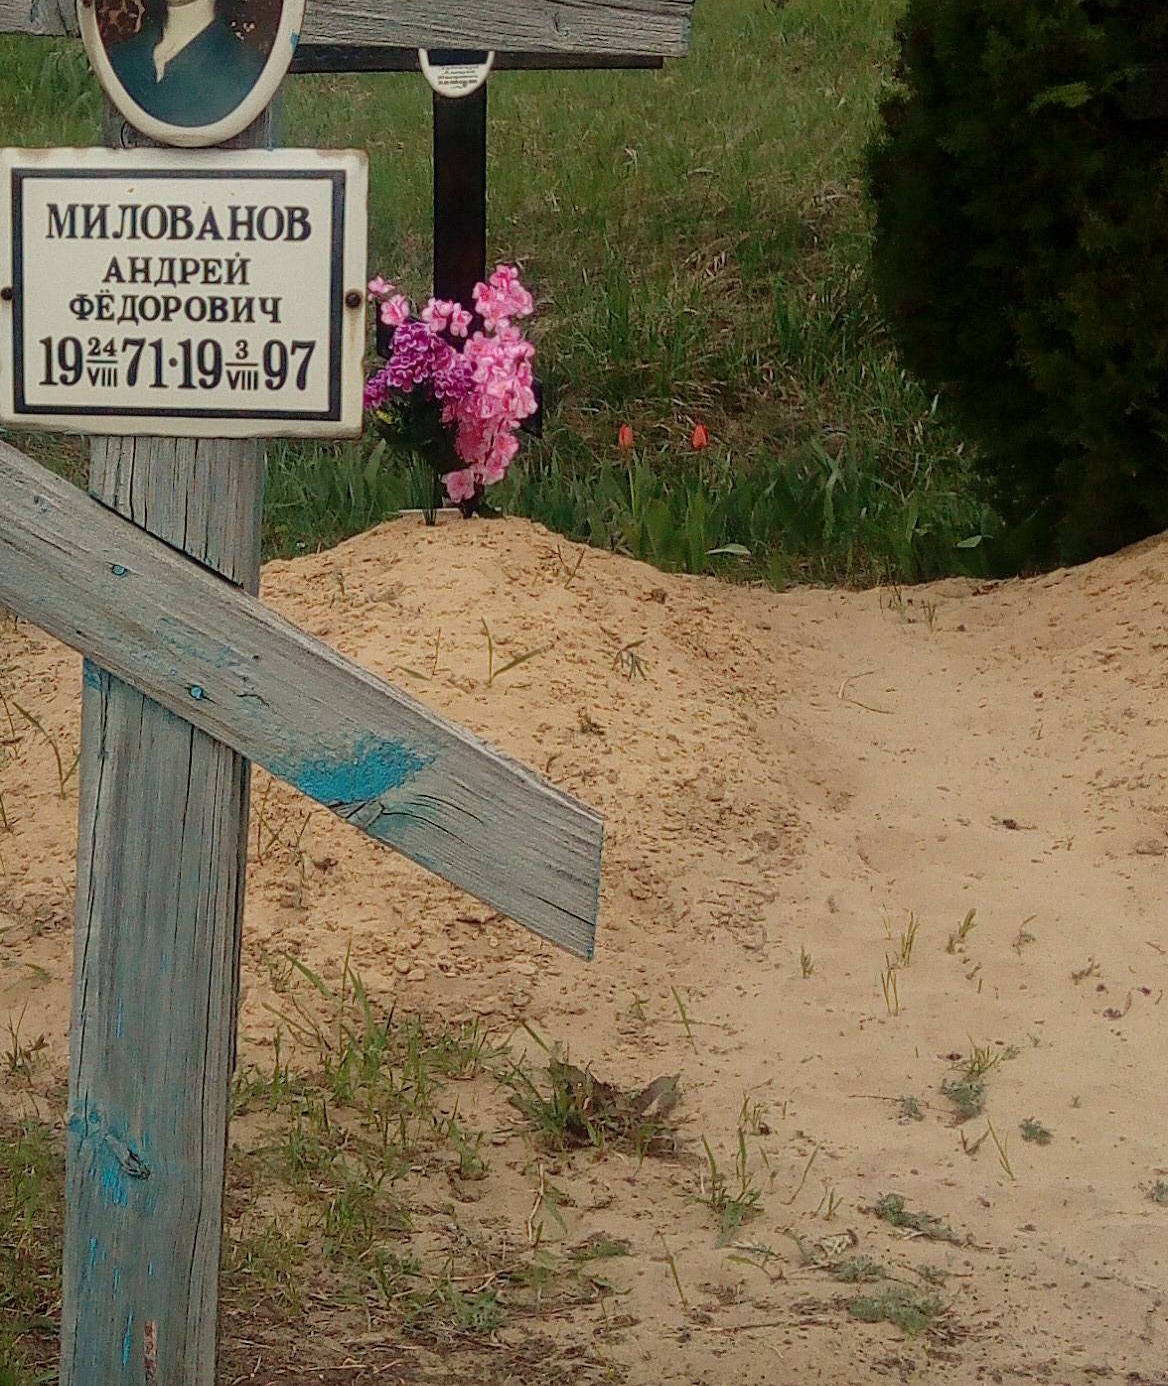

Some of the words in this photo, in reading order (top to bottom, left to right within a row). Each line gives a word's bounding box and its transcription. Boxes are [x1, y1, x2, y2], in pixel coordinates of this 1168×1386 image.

[45, 203, 312, 242] МИЛОВАНОВ
[101, 252, 251, 288] АНДРЕЙ
[69, 289, 283, 327] ФЁДОРОВИЧ
